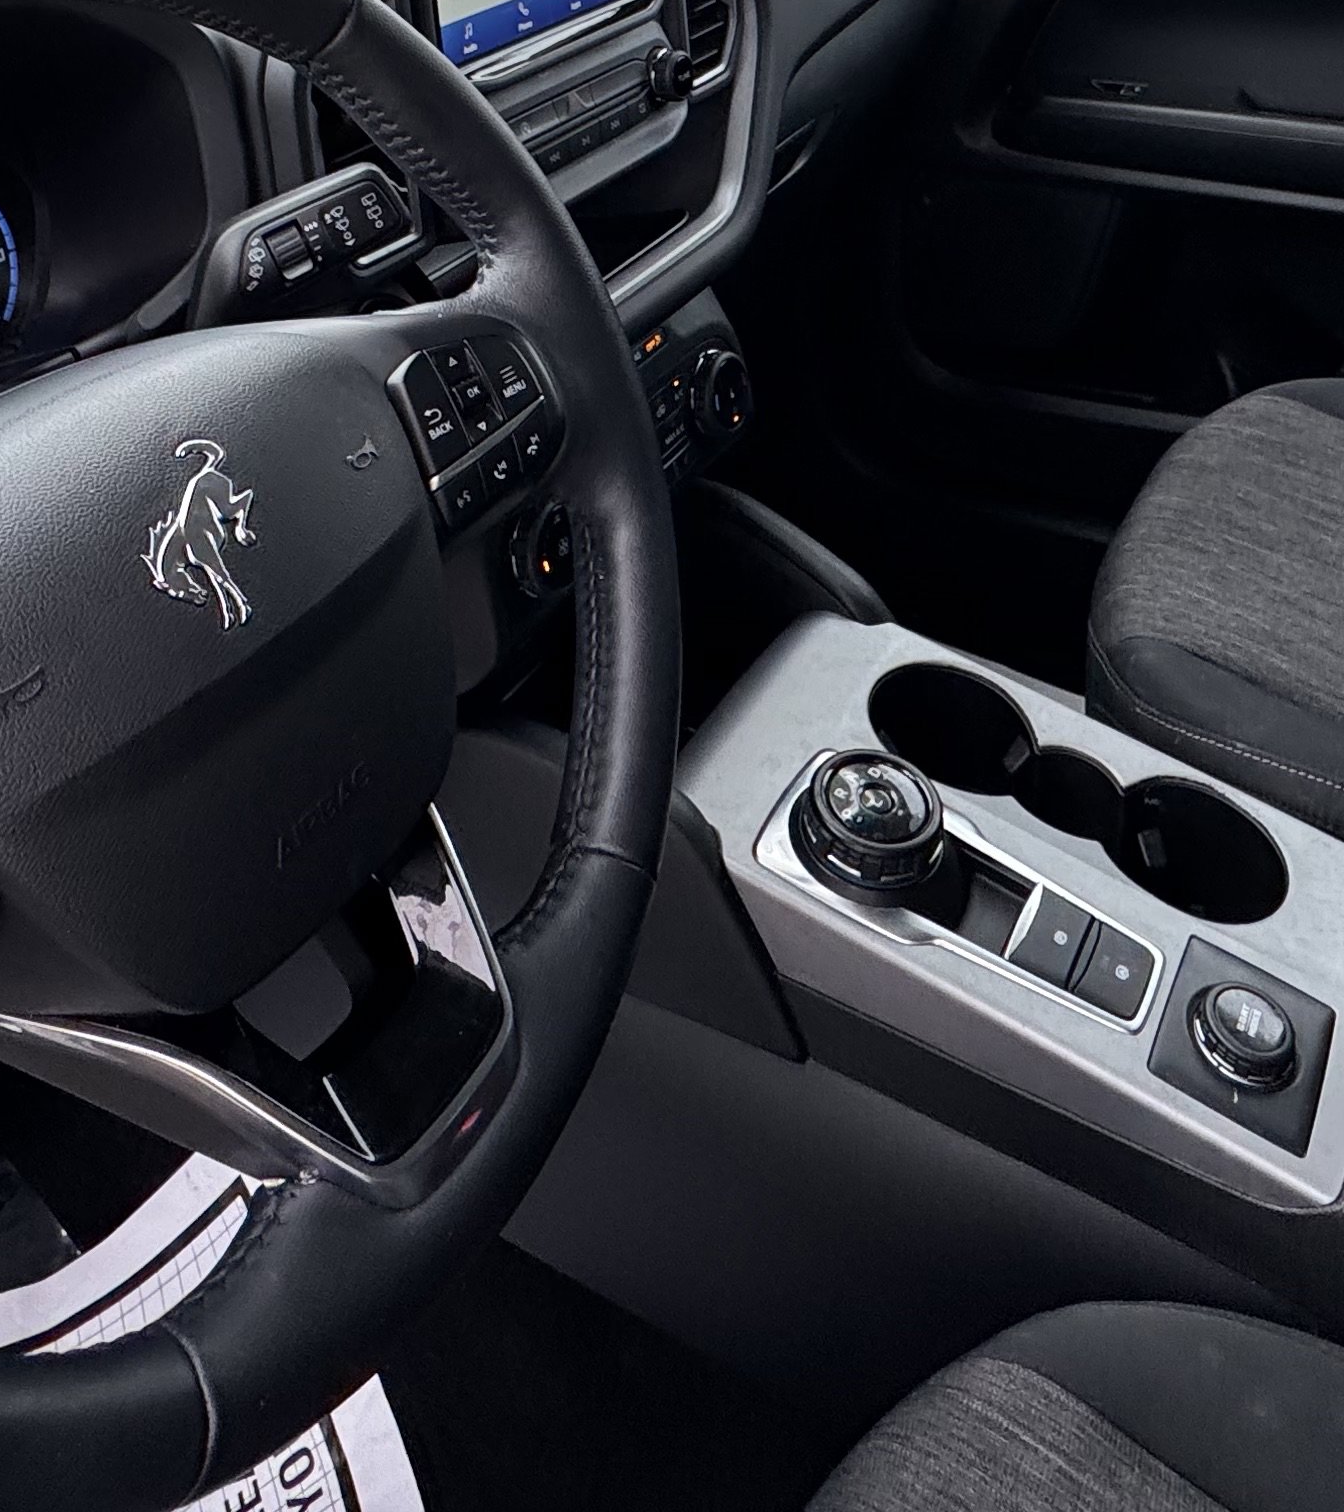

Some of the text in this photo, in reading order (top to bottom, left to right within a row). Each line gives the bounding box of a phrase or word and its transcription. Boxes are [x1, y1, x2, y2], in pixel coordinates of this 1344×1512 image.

[466, 385, 481, 399] OK
[502, 379, 527, 399] MENU
[427, 420, 454, 441] BACK
